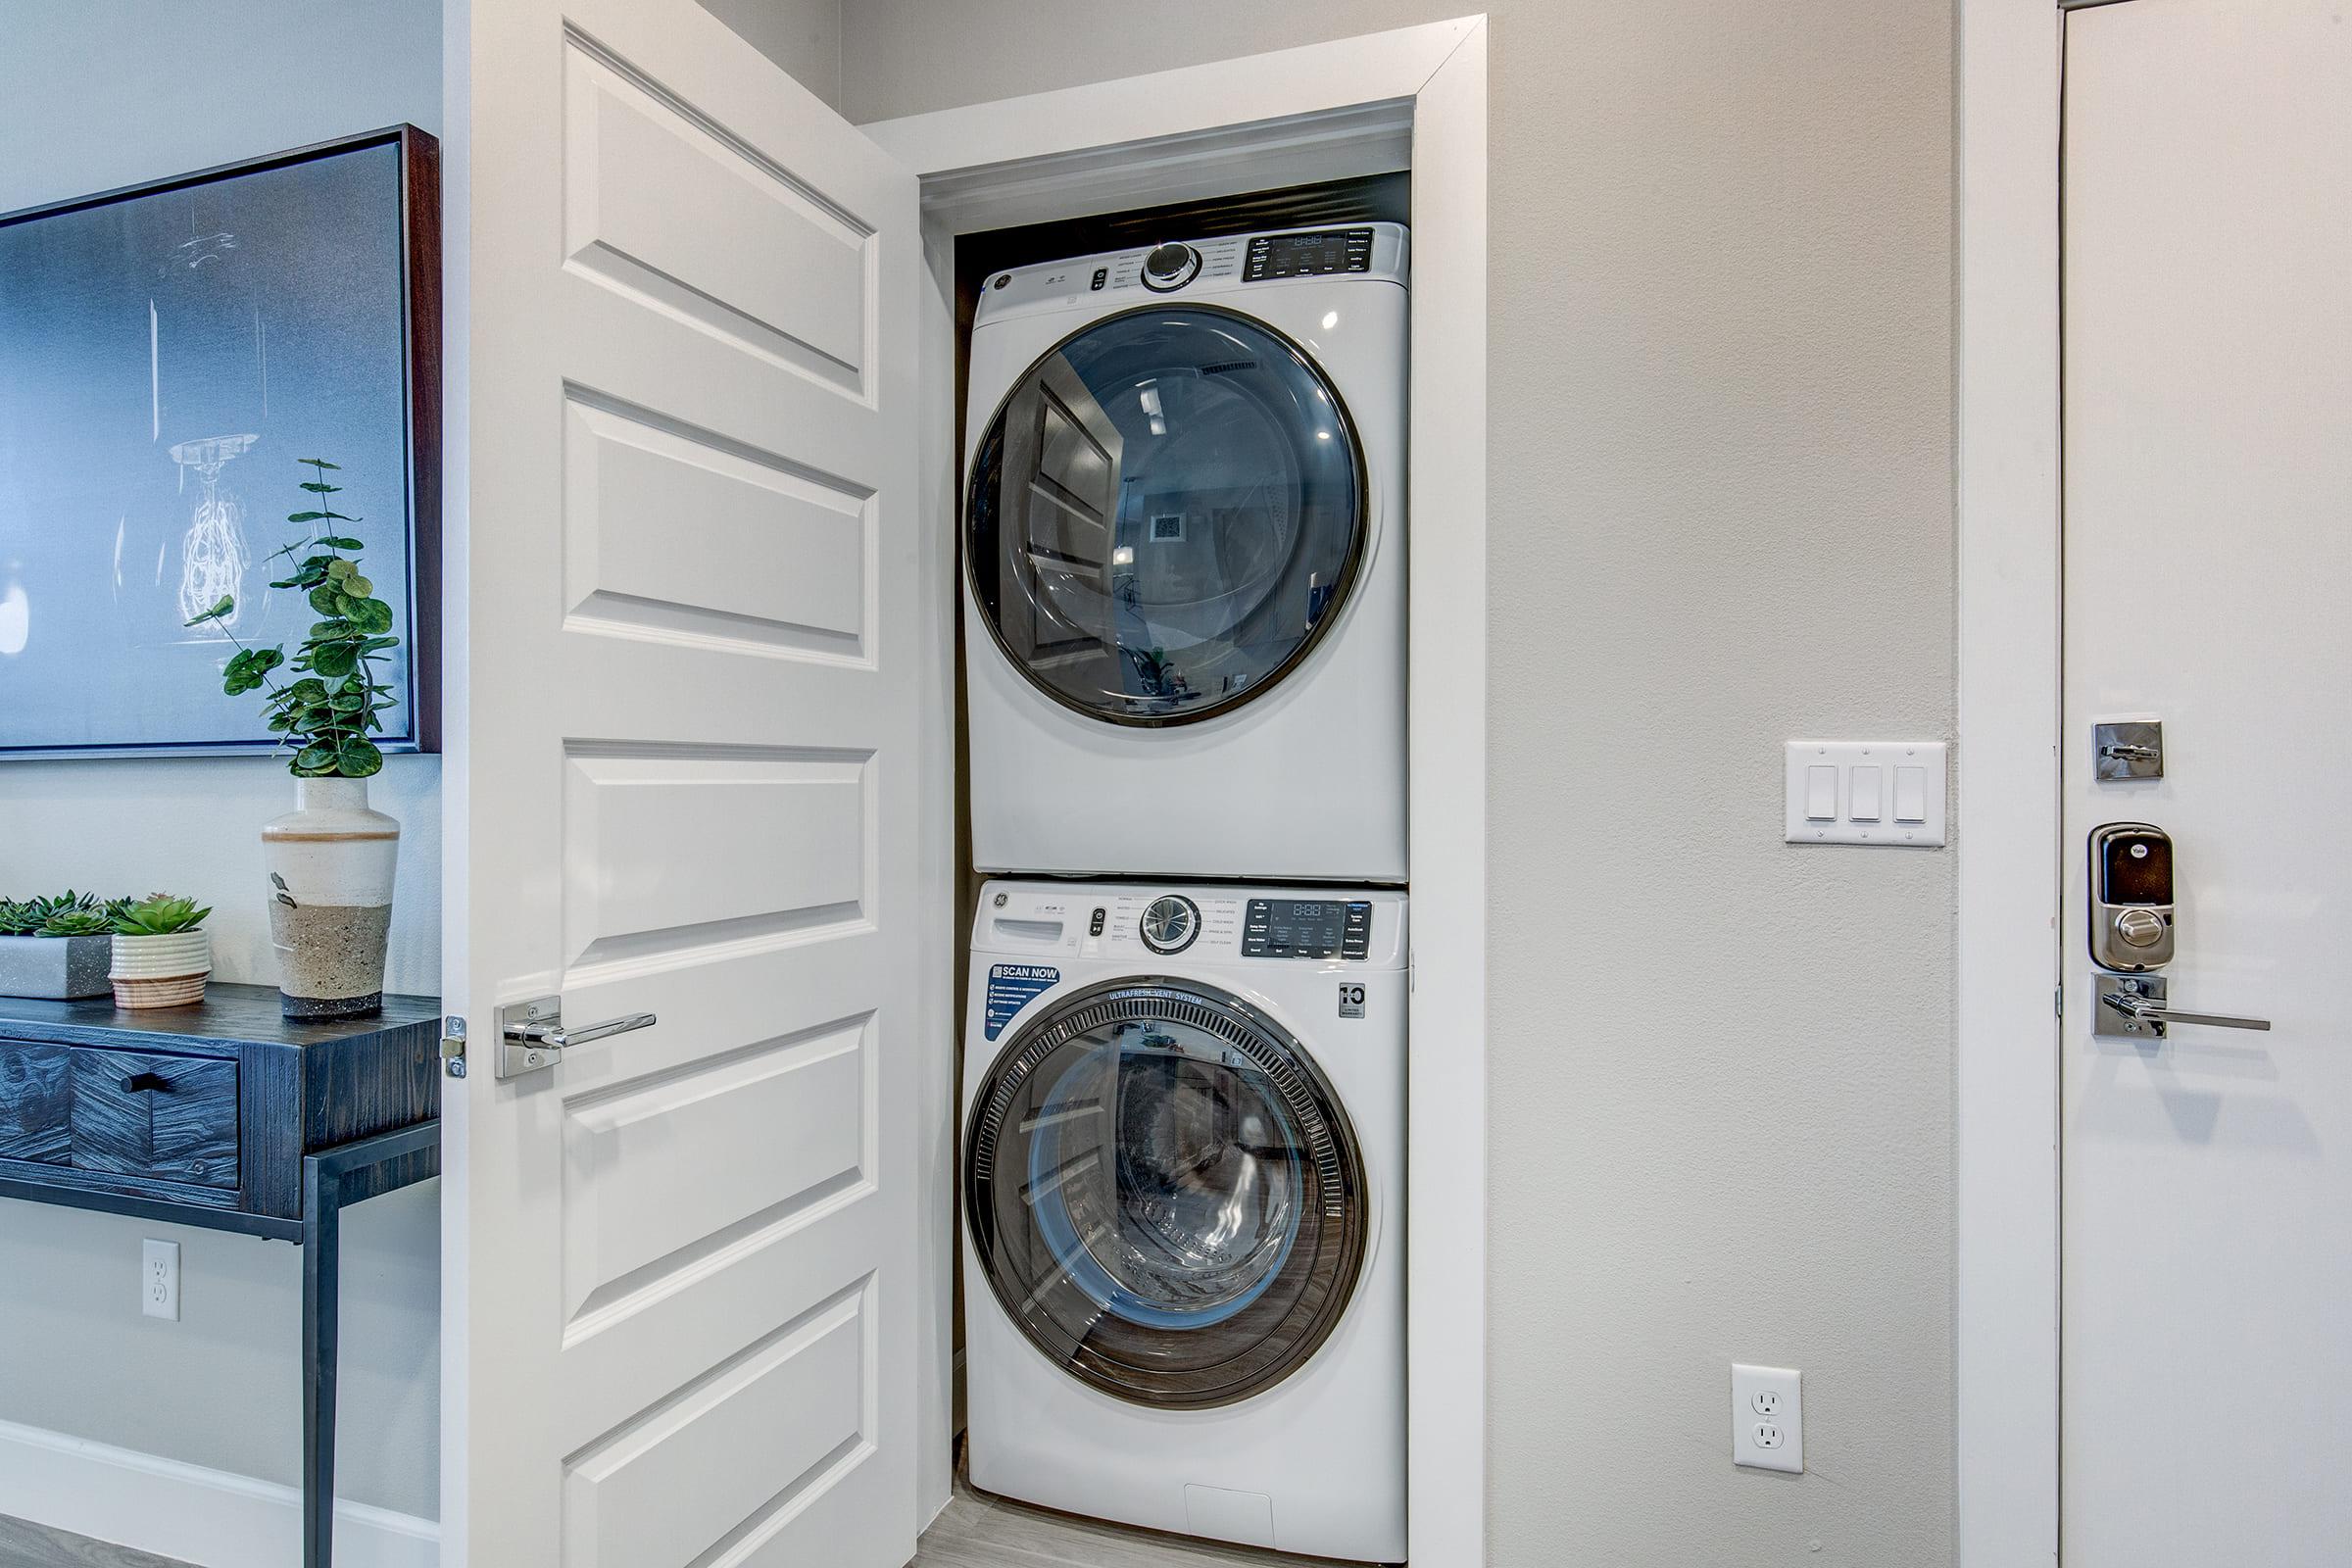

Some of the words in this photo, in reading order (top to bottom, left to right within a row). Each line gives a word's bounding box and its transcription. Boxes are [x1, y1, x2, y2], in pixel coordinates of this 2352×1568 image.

[1003, 966, 1029, 977] SCAN
[1031, 968, 1057, 979] NOW
[1108, 989, 1152, 1001] ULTRAFRESH
[1154, 990, 1172, 999] VENT
[1175, 992, 1202, 1005] SYSTEM
[1340, 986, 1365, 1004] 10
